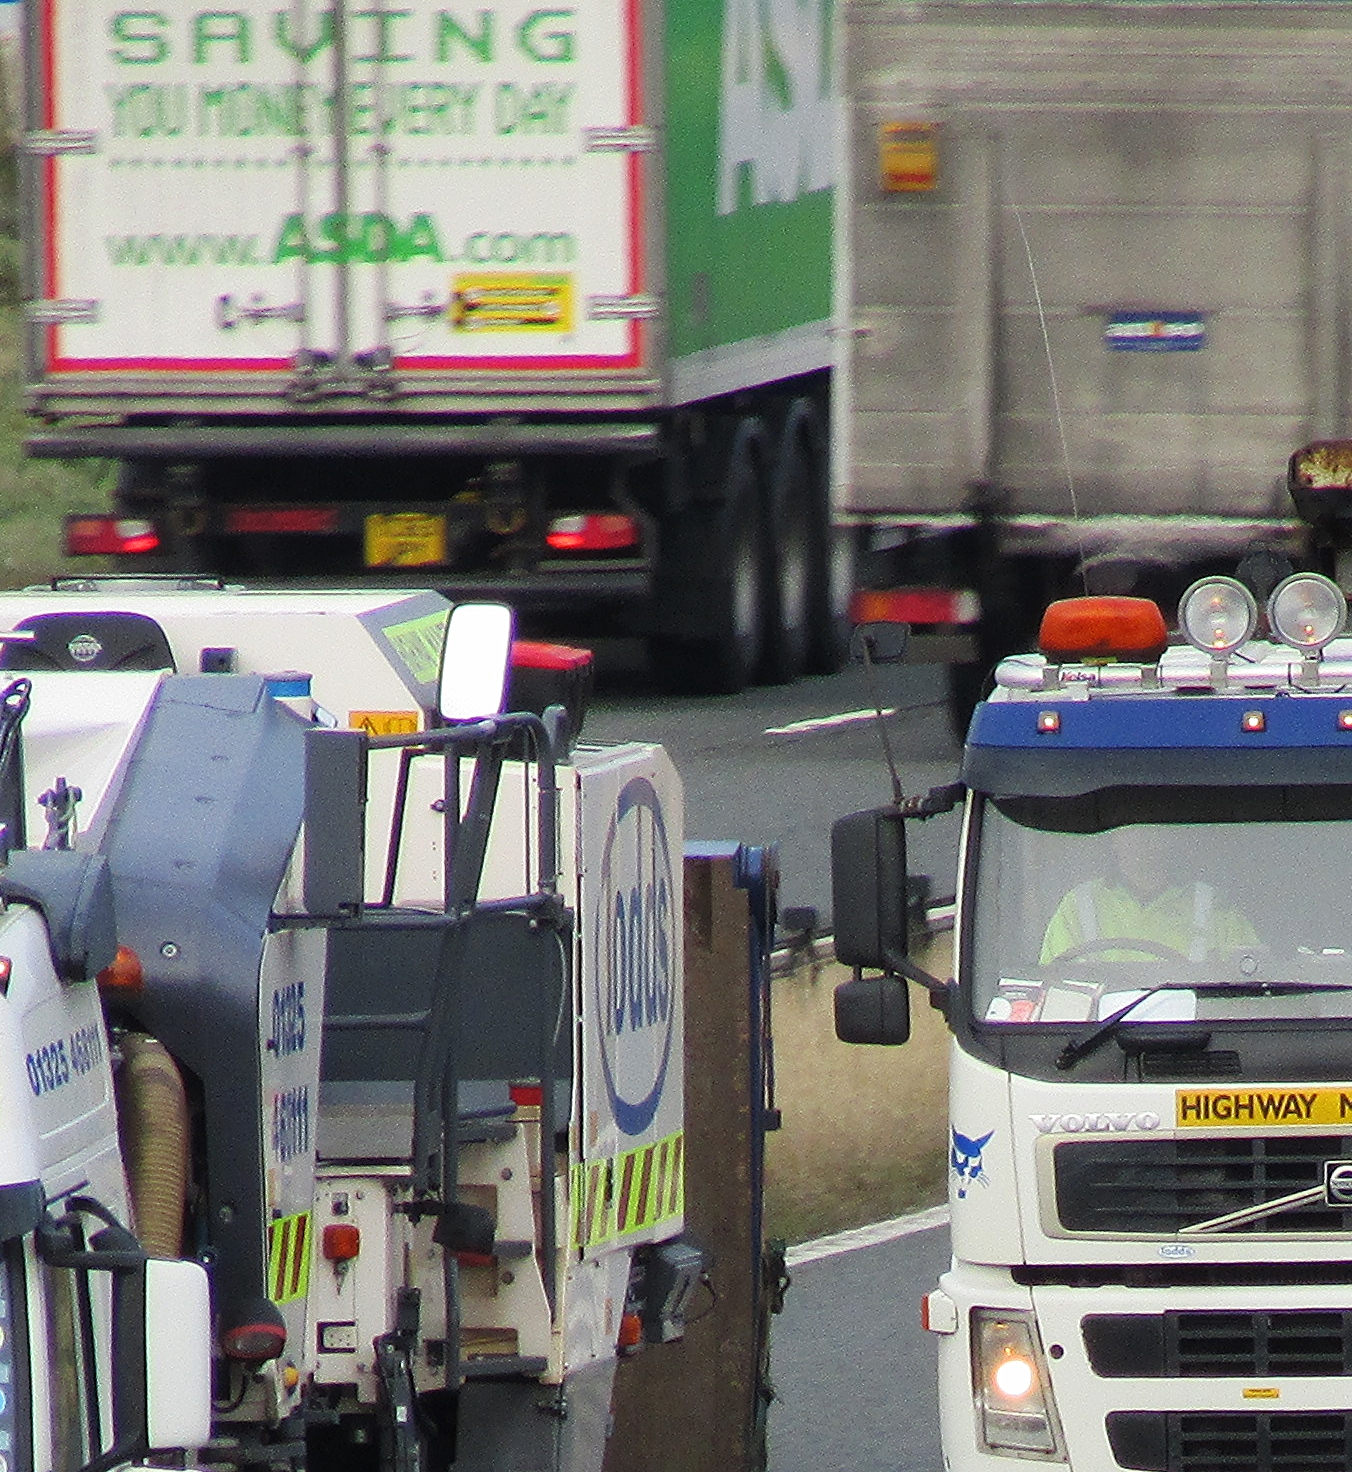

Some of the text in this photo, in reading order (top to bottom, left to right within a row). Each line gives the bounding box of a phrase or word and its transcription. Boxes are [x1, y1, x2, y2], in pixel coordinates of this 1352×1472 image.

[110, 8, 577, 65] SAVING
[104, 82, 188, 137] YOU
[352, 82, 485, 137] EVERY
[495, 82, 577, 137] DAY
[108, 211, 577, 265] www.ASDA.com
[26, 1038, 69, 1096] 01325
[1028, 1111, 1161, 1133] VOLVO
[1180, 1093, 1319, 1120] HIGHWAY
